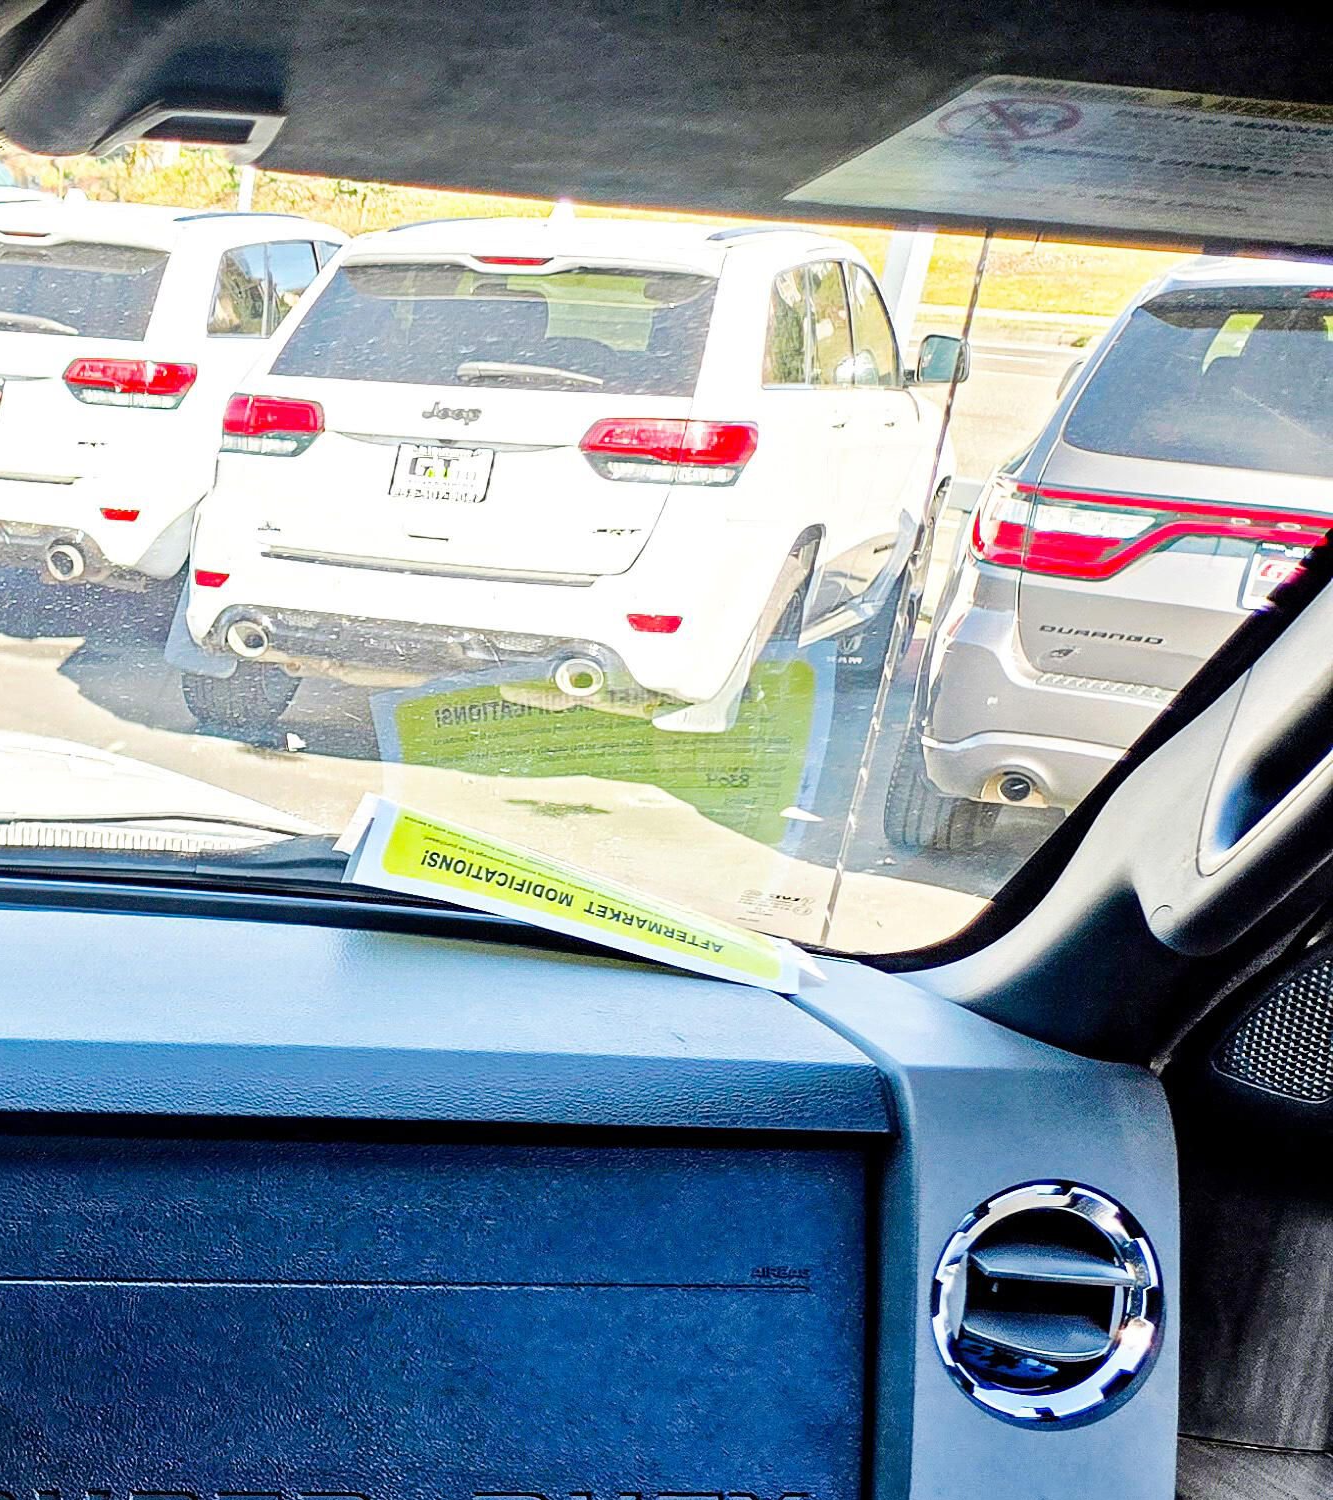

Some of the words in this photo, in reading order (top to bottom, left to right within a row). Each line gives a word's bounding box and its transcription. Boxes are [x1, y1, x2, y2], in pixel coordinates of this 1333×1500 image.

[421, 401, 483, 425] Jeep
[1040, 624, 1166, 645] DURANGO
[420, 849, 574, 908] MODIFICATIONS!
[584, 901, 724, 954] AFTERMARKET
